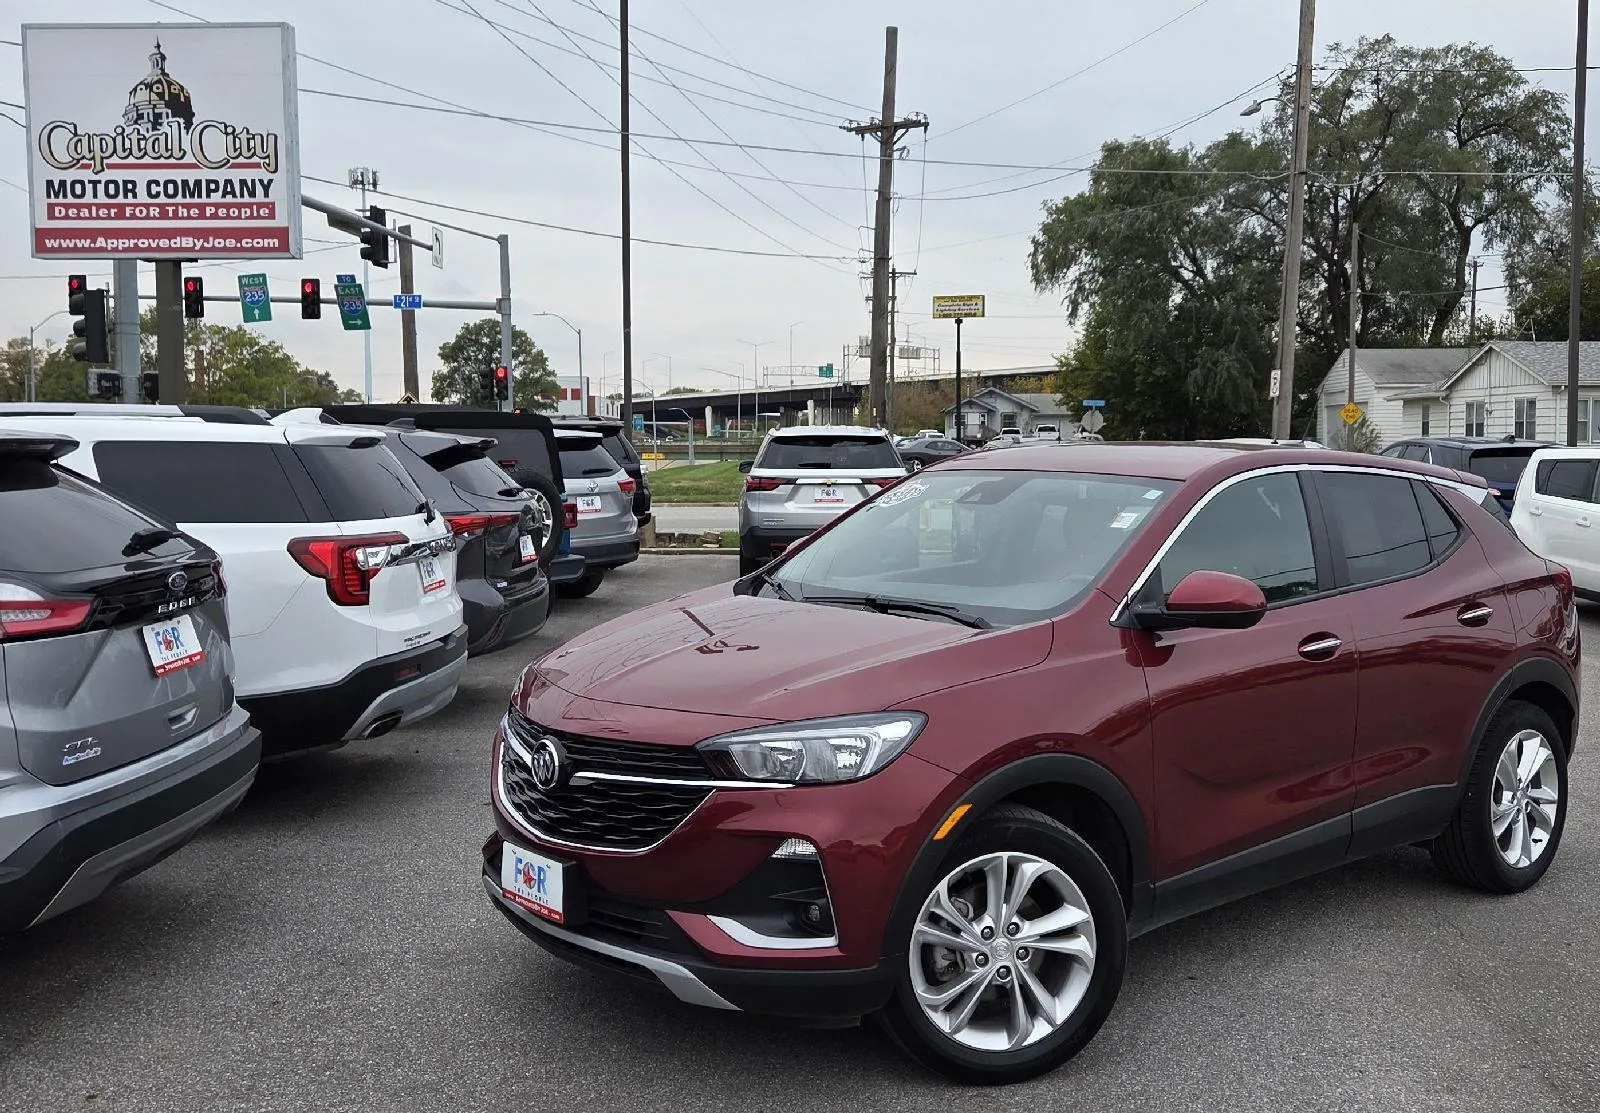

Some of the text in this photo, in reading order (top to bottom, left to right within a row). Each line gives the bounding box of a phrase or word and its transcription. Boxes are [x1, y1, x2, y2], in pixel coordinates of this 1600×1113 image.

[39, 119, 278, 173] Capital City
[46, 178, 274, 200] MOTOR COMPANY
[54, 204, 271, 220] Dealer FOR The People
[45, 236, 279, 251] www.ApprovedByJoe.com
[241, 276, 264, 285] WEST
[245, 291, 265, 302] 235
[338, 286, 359, 295] EAST
[343, 301, 362, 310] 235
[158, 596, 195, 613] EDGE
[155, 627, 184, 654] FOR
[514, 857, 548, 895] FOR
